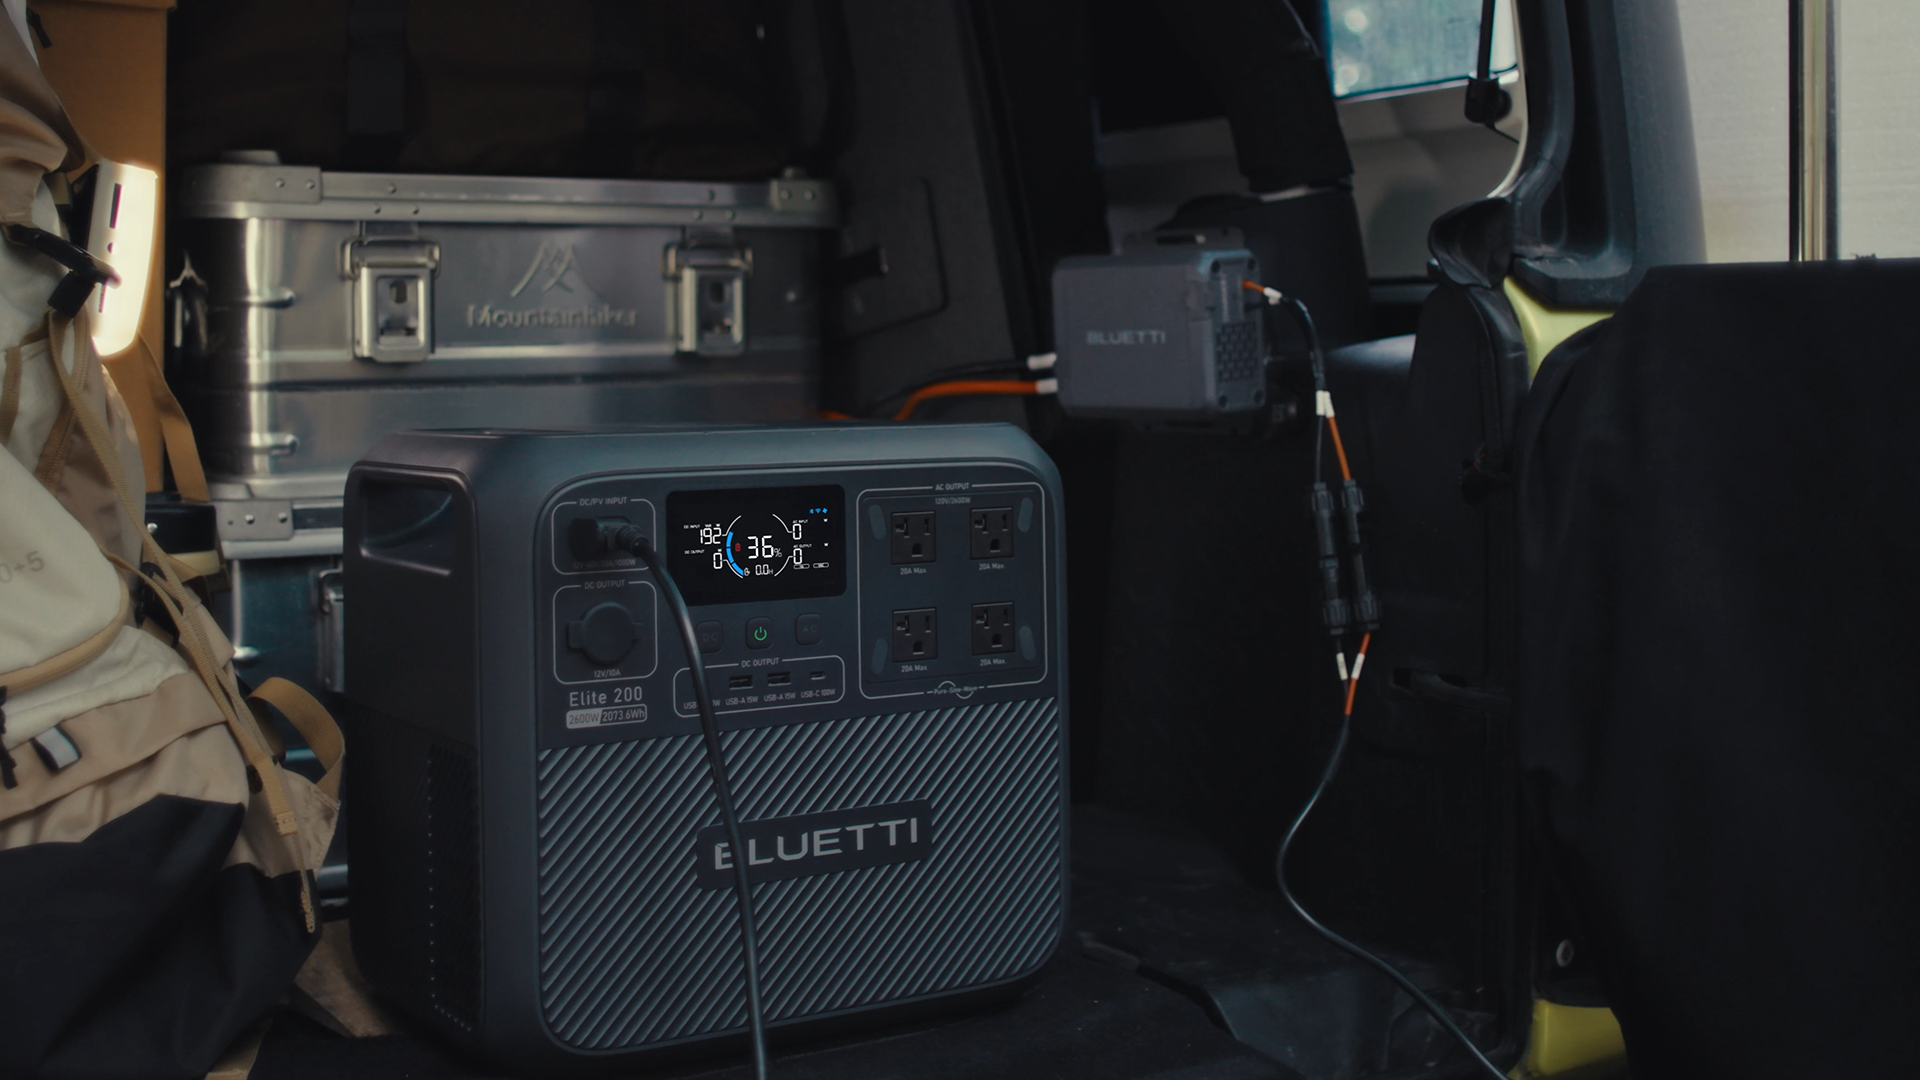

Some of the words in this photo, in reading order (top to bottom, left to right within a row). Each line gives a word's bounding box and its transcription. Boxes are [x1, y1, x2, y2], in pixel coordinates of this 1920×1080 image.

[1086, 329, 1167, 345] BLUETTI
[935, 483, 944, 491] AC
[945, 482, 970, 490] OUTPUT
[579, 498, 603, 506] DC/PV
[605, 496, 627, 505] INPUT
[935, 497, 971, 505] 120V/2600W
[700, 527, 722, 545] 192
[792, 523, 802, 540] 0
[713, 552, 722, 569] 0
[793, 548, 803, 565] 0
[900, 567, 912, 575] 20A
[979, 563, 991, 571] 20A
[584, 581, 595, 589] DC
[596, 579, 625, 588] OUTPUT
[802, 624, 818, 633] AC
[702, 633, 718, 642] DC
[741, 659, 752, 668] DC
[752, 657, 780, 666] OUTPUT
[980, 658, 992, 666] 20A
[594, 669, 621, 678] 12V/10A
[901, 665, 913, 673] 20A
[569, 691, 607, 707] Elite
[614, 686, 643, 703] 200
[763, 693, 783, 702] USB-A
[784, 692, 796, 700] 15W
[801, 689, 820, 698] USB-C
[820, 688, 836, 697] 100W
[725, 697, 746, 706] USB-A
[746, 696, 759, 704] 15W
[569, 711, 599, 725] 2600W
[602, 708, 646, 723] 2073.6Wh
[714, 817, 918, 870] BLUETTI
